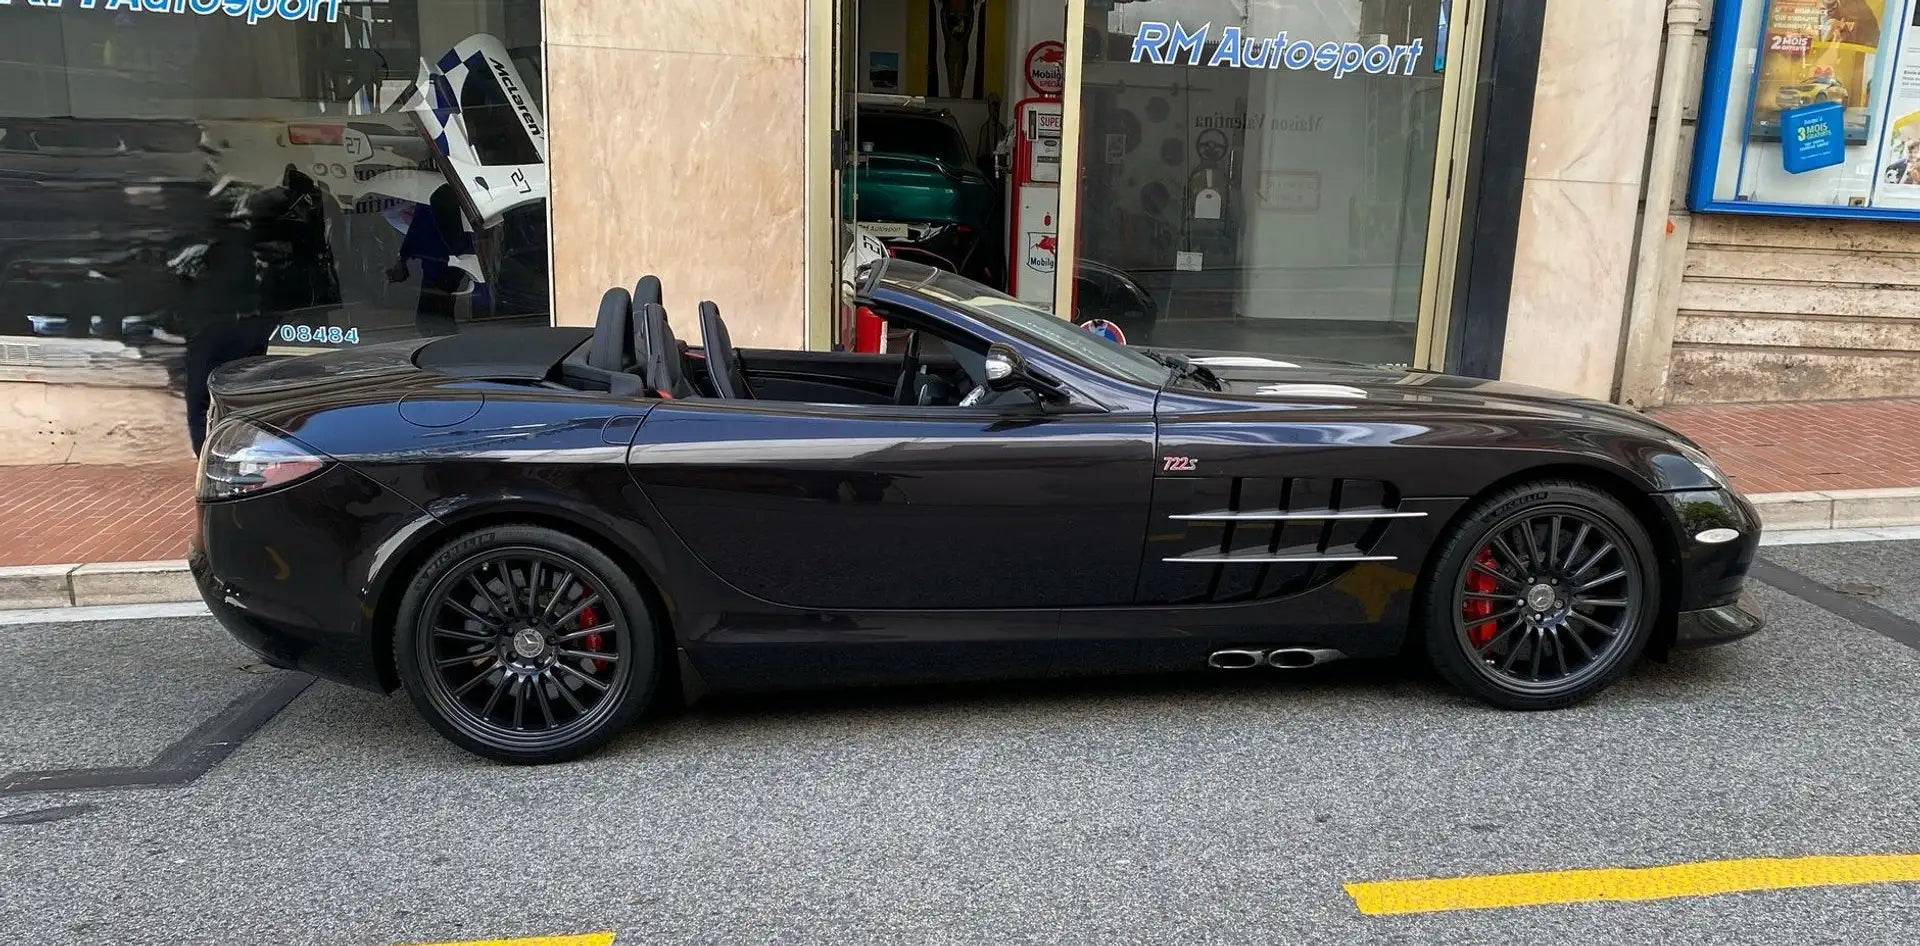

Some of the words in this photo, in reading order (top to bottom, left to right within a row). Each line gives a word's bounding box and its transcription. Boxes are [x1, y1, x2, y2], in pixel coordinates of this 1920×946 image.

[105, 0, 342, 25] sport
[1130, 20, 1211, 66] RM
[1208, 26, 1423, 79] Autosport
[1770, 35, 1782, 50] 2
[1782, 37, 1808, 46] MOIS
[489, 57, 541, 136] McLaren
[1797, 127, 1806, 141] 3
[1806, 122, 1828, 134] MOIS
[345, 136, 361, 154] 27
[510, 168, 532, 194] 27
[863, 234, 881, 255] 27
